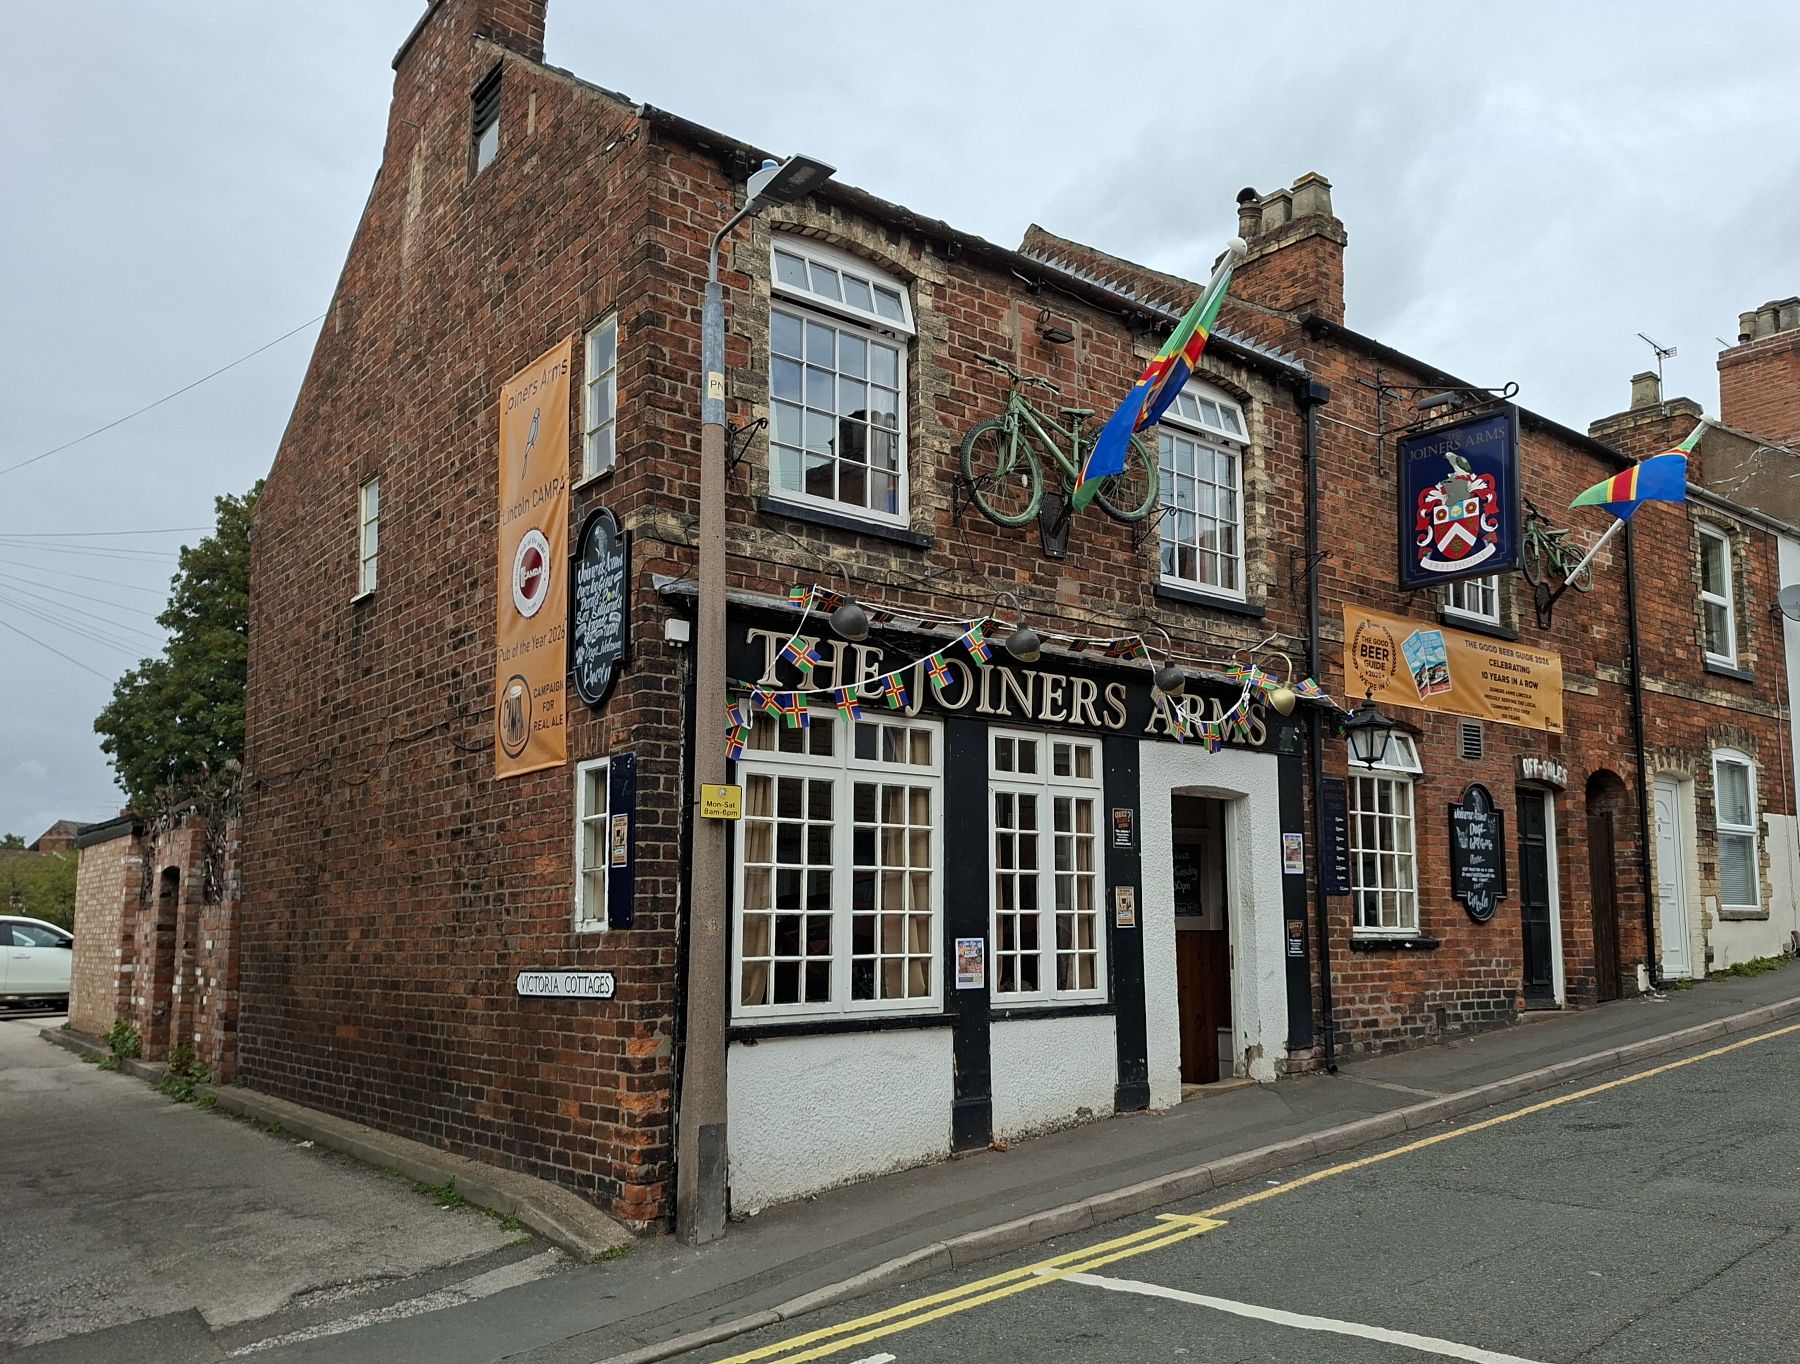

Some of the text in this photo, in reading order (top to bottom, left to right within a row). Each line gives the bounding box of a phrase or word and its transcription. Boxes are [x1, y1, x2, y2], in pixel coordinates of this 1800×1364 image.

[504, 358, 568, 415] Joiners Arms
[710, 380, 724, 391] PN
[1408, 427, 1505, 462] JOINERS ARMS
[502, 476, 565, 526] Lincoln CAMRA
[1430, 551, 1486, 570] FREE HOUSE
[498, 648, 510, 663] Pub
[512, 646, 520, 658] of
[520, 640, 530, 656] the
[531, 634, 547, 650] Year
[548, 624, 565, 644] 2026
[1361, 636, 1389, 648] THE GOOD
[1464, 640, 1478, 650] THE
[1478, 642, 1498, 654] GOOD
[1499, 647, 1514, 658] BEER
[1516, 650, 1534, 662] GUIDE
[1360, 644, 1390, 662] BEER
[1364, 660, 1386, 671] GUIDE
[1488, 658, 1530, 674] CELEBRATING
[534, 680, 564, 698] CAMPAIGN
[746, 628, 1267, 746] THE JOINERS ARMS
[1378, 682, 1386, 690] IN
[1481, 671, 1488, 680] 10
[1490, 672, 1510, 684] YEARS
[1511, 678, 1518, 686] IN
[1524, 680, 1538, 690] ROW
[1489, 686, 1503, 694] JOINERS
[542, 699, 554, 713] FOR
[1490, 703, 1513, 712] COMMUNITY
[1520, 706, 1530, 715] OVER
[534, 714, 564, 732] REAL ALE
[1523, 758, 1568, 783] OFF-SALES
[704, 808, 738, 816] 8am-6pm
[706, 800, 736, 808] Mon-Sat
[521, 976, 610, 994] VICTORIA COTTAGES
